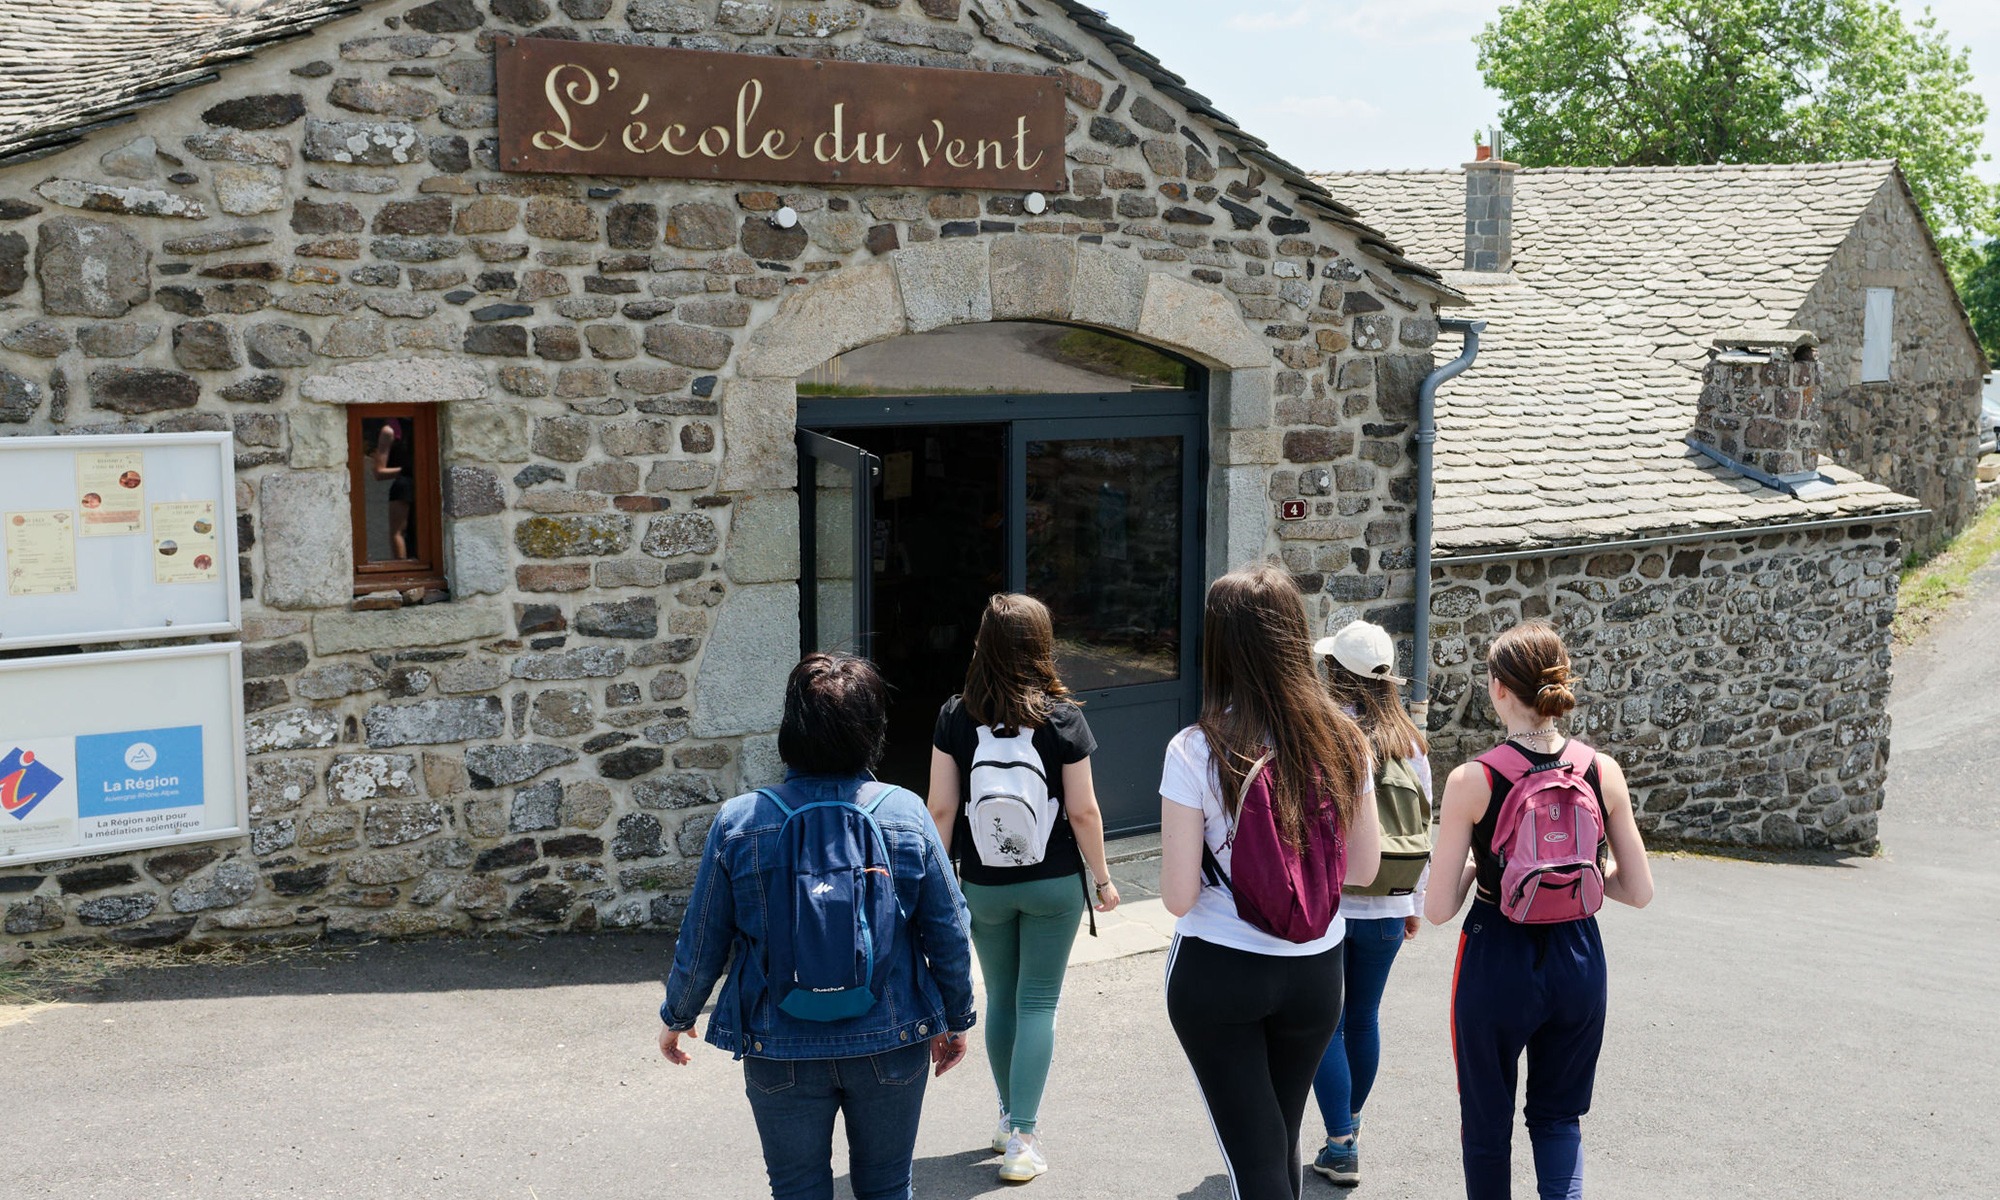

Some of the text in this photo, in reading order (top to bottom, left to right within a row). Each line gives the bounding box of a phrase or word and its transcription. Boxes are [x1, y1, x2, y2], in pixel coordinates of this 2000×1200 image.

[532, 63, 1043, 171] L'école du vent
[1290, 503, 1299, 516] 4
[103, 775, 179, 793] La Région
[97, 812, 188, 828] La Région agit pour
[84, 820, 200, 839] la médiation scientifique
